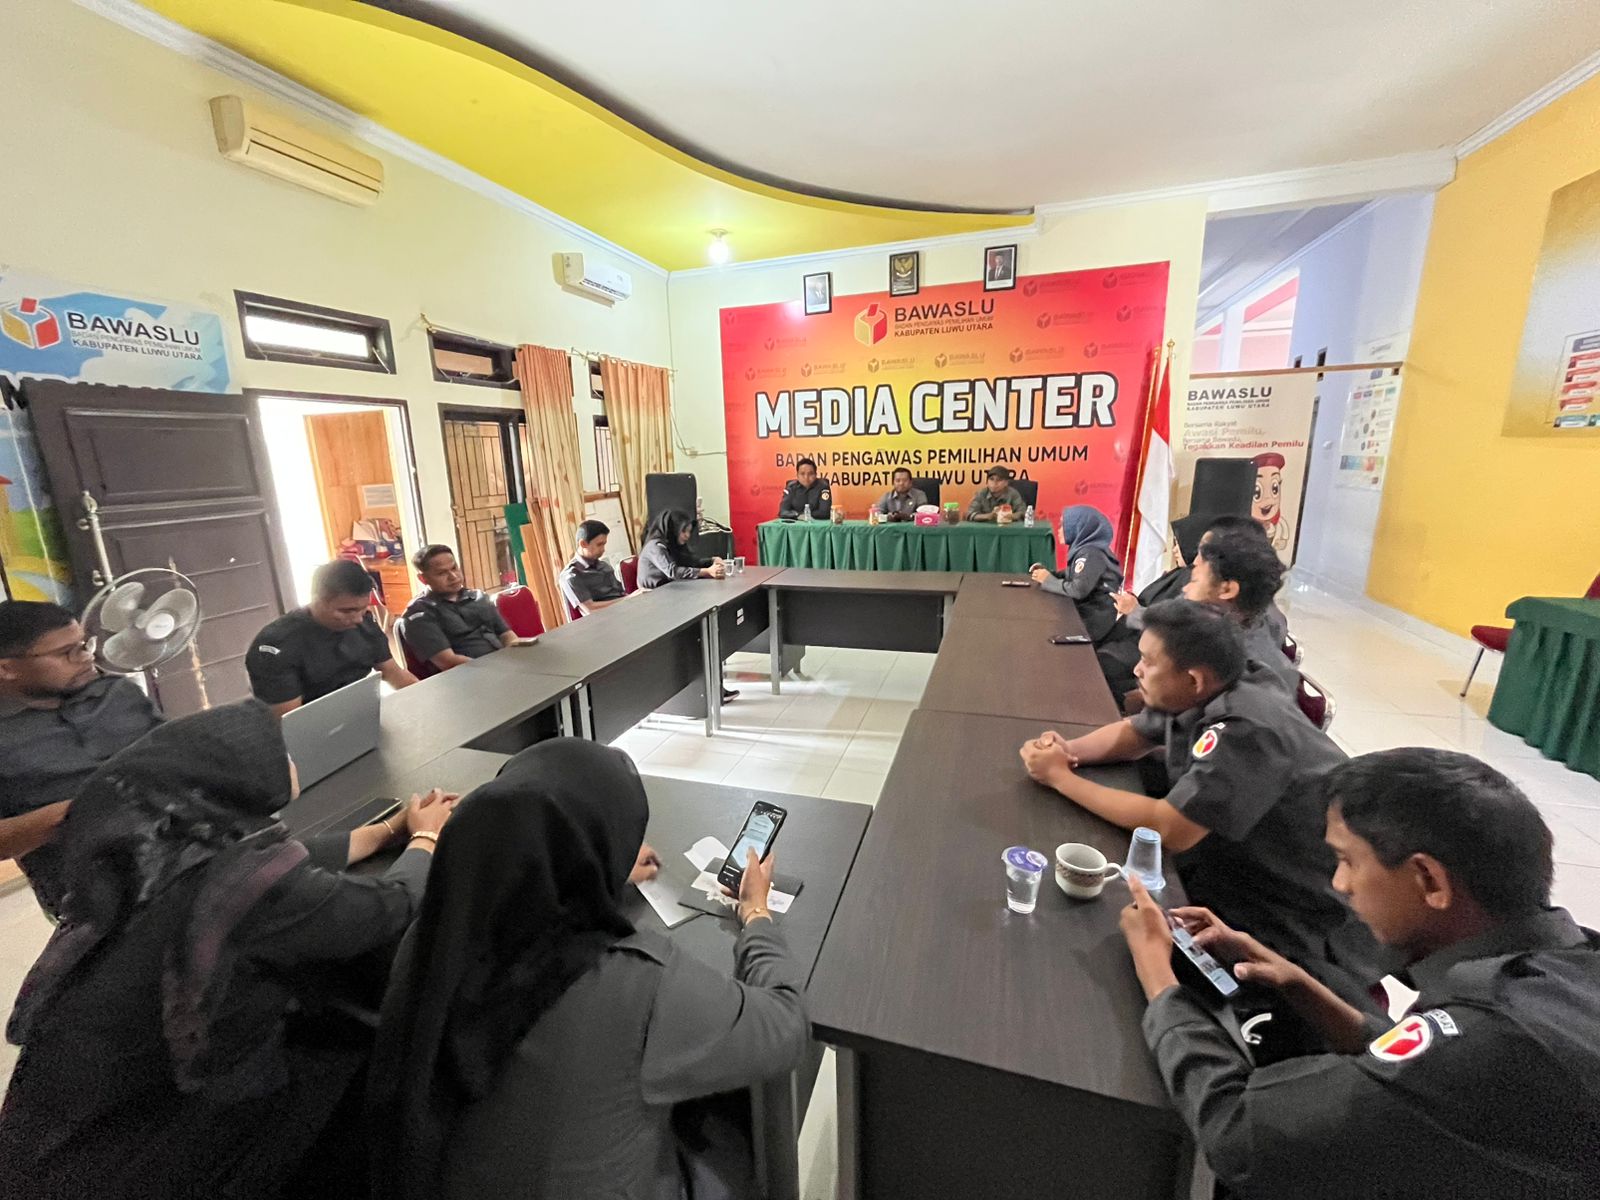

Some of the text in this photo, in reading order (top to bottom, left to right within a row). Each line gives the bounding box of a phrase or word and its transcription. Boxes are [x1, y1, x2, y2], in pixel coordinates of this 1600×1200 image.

[894, 298, 994, 322] BAWASLU
[66, 311, 200, 346] BAWASLU
[894, 323, 993, 337] KABUPATEN LUWU UTARA
[72, 339, 203, 361] KABUPATEN LUWU UTARA
[756, 371, 1118, 438] MEDIA CENTER
[1187, 386, 1272, 401] BAWASLU
[776, 445, 1088, 467] BADAN PENGAWAS PEMILIHAN UMUM
[1183, 440, 1304, 452] Tegakkan Keadilan Pemilu
[819, 469, 897, 487] KABUPAT
[972, 468, 1030, 485] UTRA
